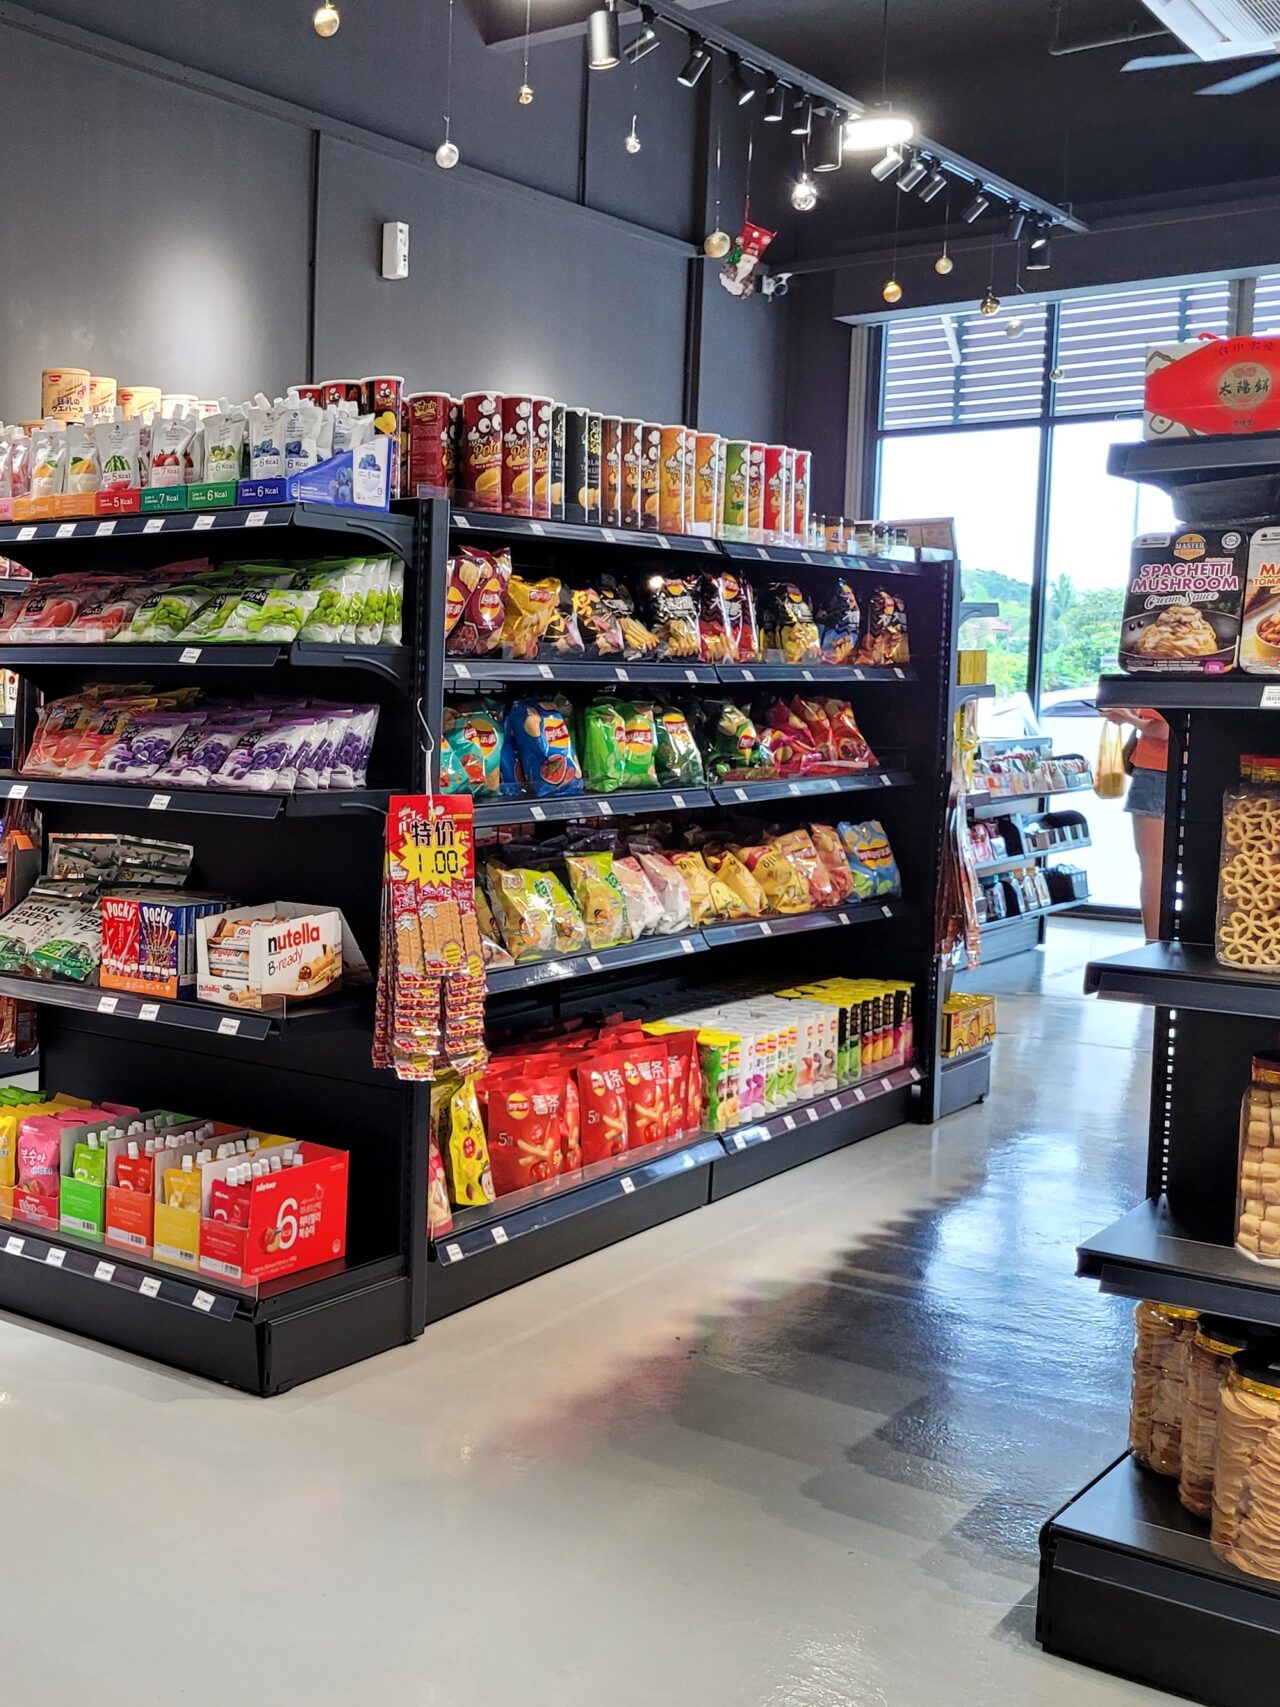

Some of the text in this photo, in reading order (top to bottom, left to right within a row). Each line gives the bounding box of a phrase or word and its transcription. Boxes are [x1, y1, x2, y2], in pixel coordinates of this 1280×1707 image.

[1218, 377, 1270, 397] 太陽餅
[159, 493, 179, 504] 7 Kcal
[207, 489, 228, 501] 6 Kcal
[257, 485, 278, 497] 6 Kcal
[113, 497, 119, 508] 5
[1140, 563, 1233, 578] SPAGHETTI
[1131, 577, 1239, 592] MUSHROOM
[1144, 591, 1220, 609] Cream Sauce
[411, 820, 455, 847] 特价
[418, 850, 459, 874] 1.00
[4, 916, 42, 926] PEAS
[268, 922, 320, 953] nutella
[268, 948, 304, 977] B-ready
[276, 1197, 299, 1250] 6
